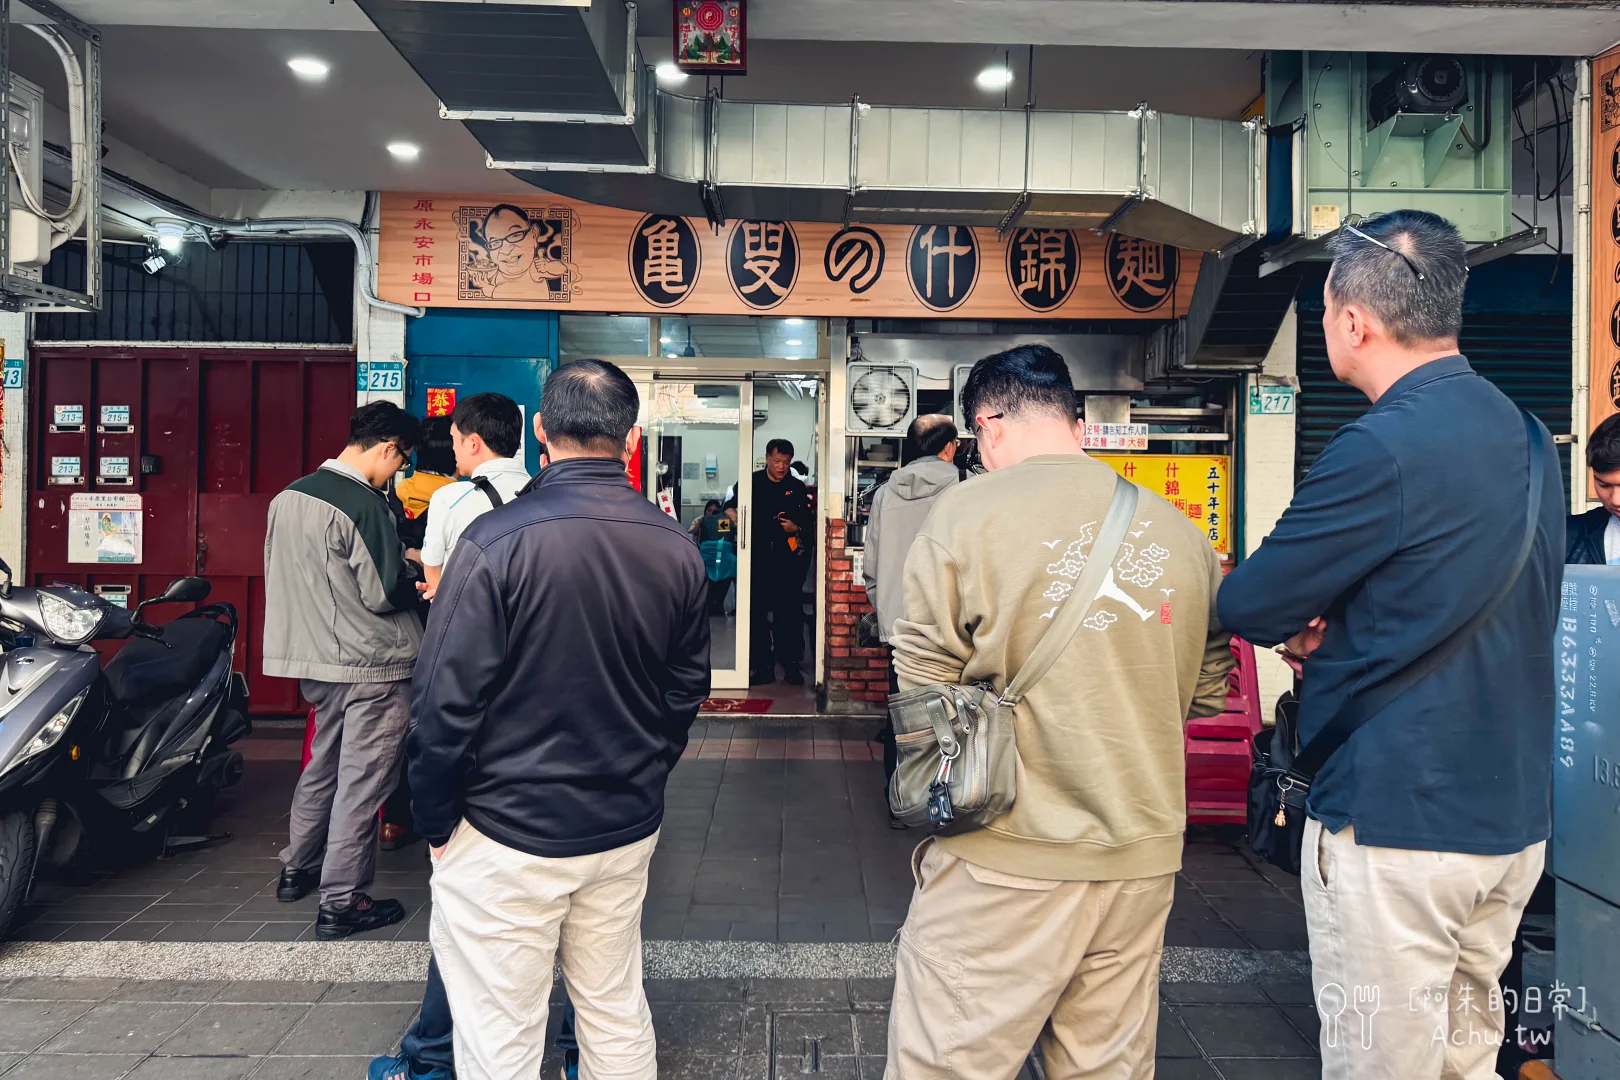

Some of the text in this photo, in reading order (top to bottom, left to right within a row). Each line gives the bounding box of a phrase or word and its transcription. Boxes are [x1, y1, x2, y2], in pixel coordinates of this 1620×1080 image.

[412, 200, 435, 302] 原永安市場口
[371, 372, 400, 388] 215
[1264, 395, 1291, 411] 217
[60, 413, 76, 422] 213
[107, 413, 122, 422] 215
[58, 465, 74, 474] 213
[106, 465, 122, 474] 215
[1123, 462, 1138, 478] 什
[1164, 462, 1180, 496] 什錦
[1206, 467, 1221, 541] 五十年老店
